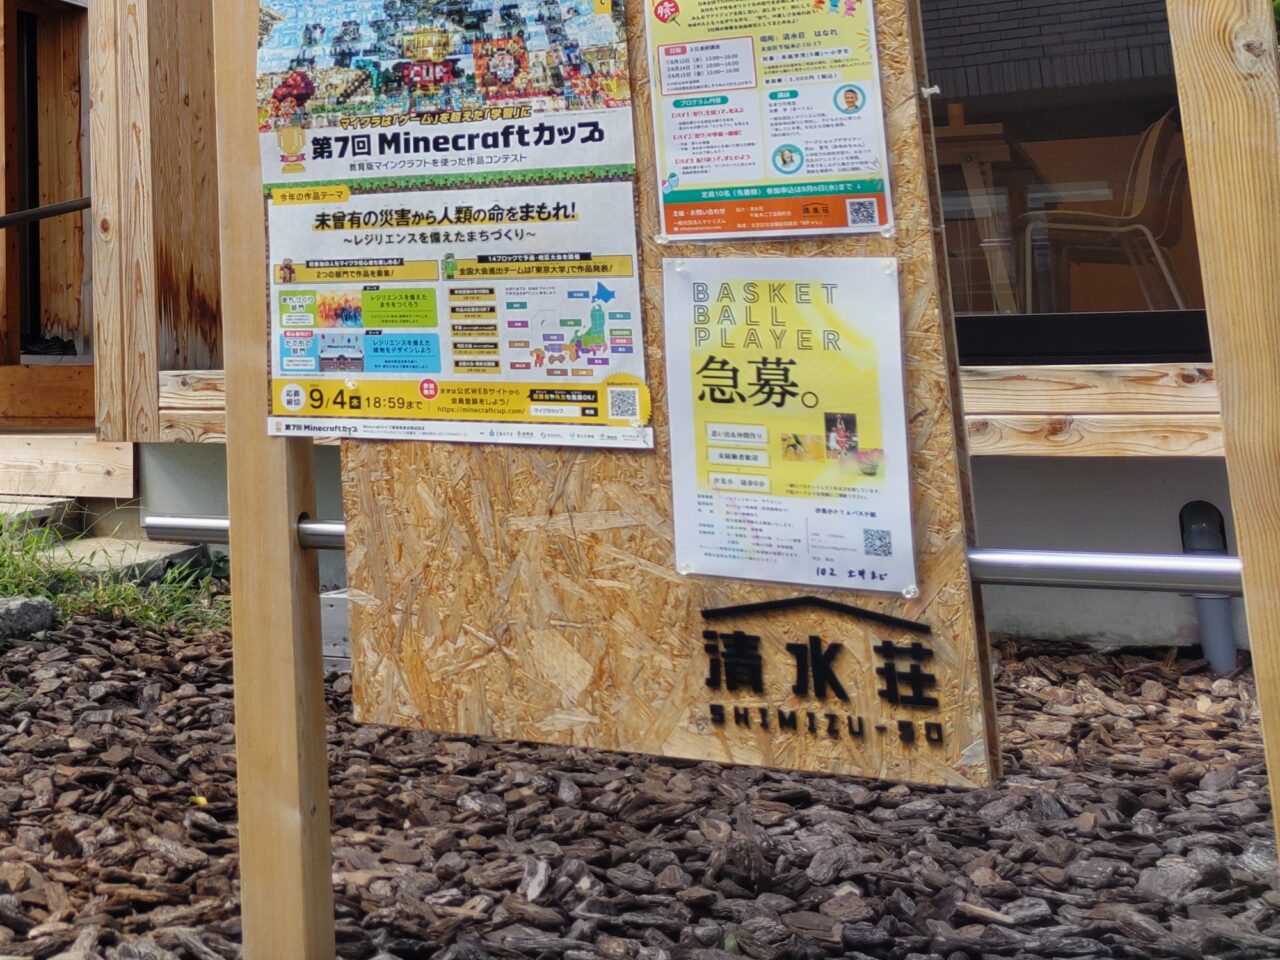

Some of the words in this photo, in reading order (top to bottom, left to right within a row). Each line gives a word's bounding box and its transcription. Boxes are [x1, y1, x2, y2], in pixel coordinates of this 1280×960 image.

[311, 132, 372, 161] 第7回
[378, 120, 605, 156] Minecraftカップ
[349, 153, 528, 172] 教育版マインクラフトを使った作品コンテスト
[280, 190, 344, 202] 今年の作品テーマ
[693, 282, 838, 305] BASKET
[693, 304, 786, 327] BALL
[694, 327, 841, 352] PLAYER
[696, 354, 819, 409] 急募。
[365, 397, 423, 410] 18:59まで
[816, 566, 837, 577] 102
[702, 630, 940, 709] 清水荘
[709, 704, 944, 744] SHIMIZU-SO
